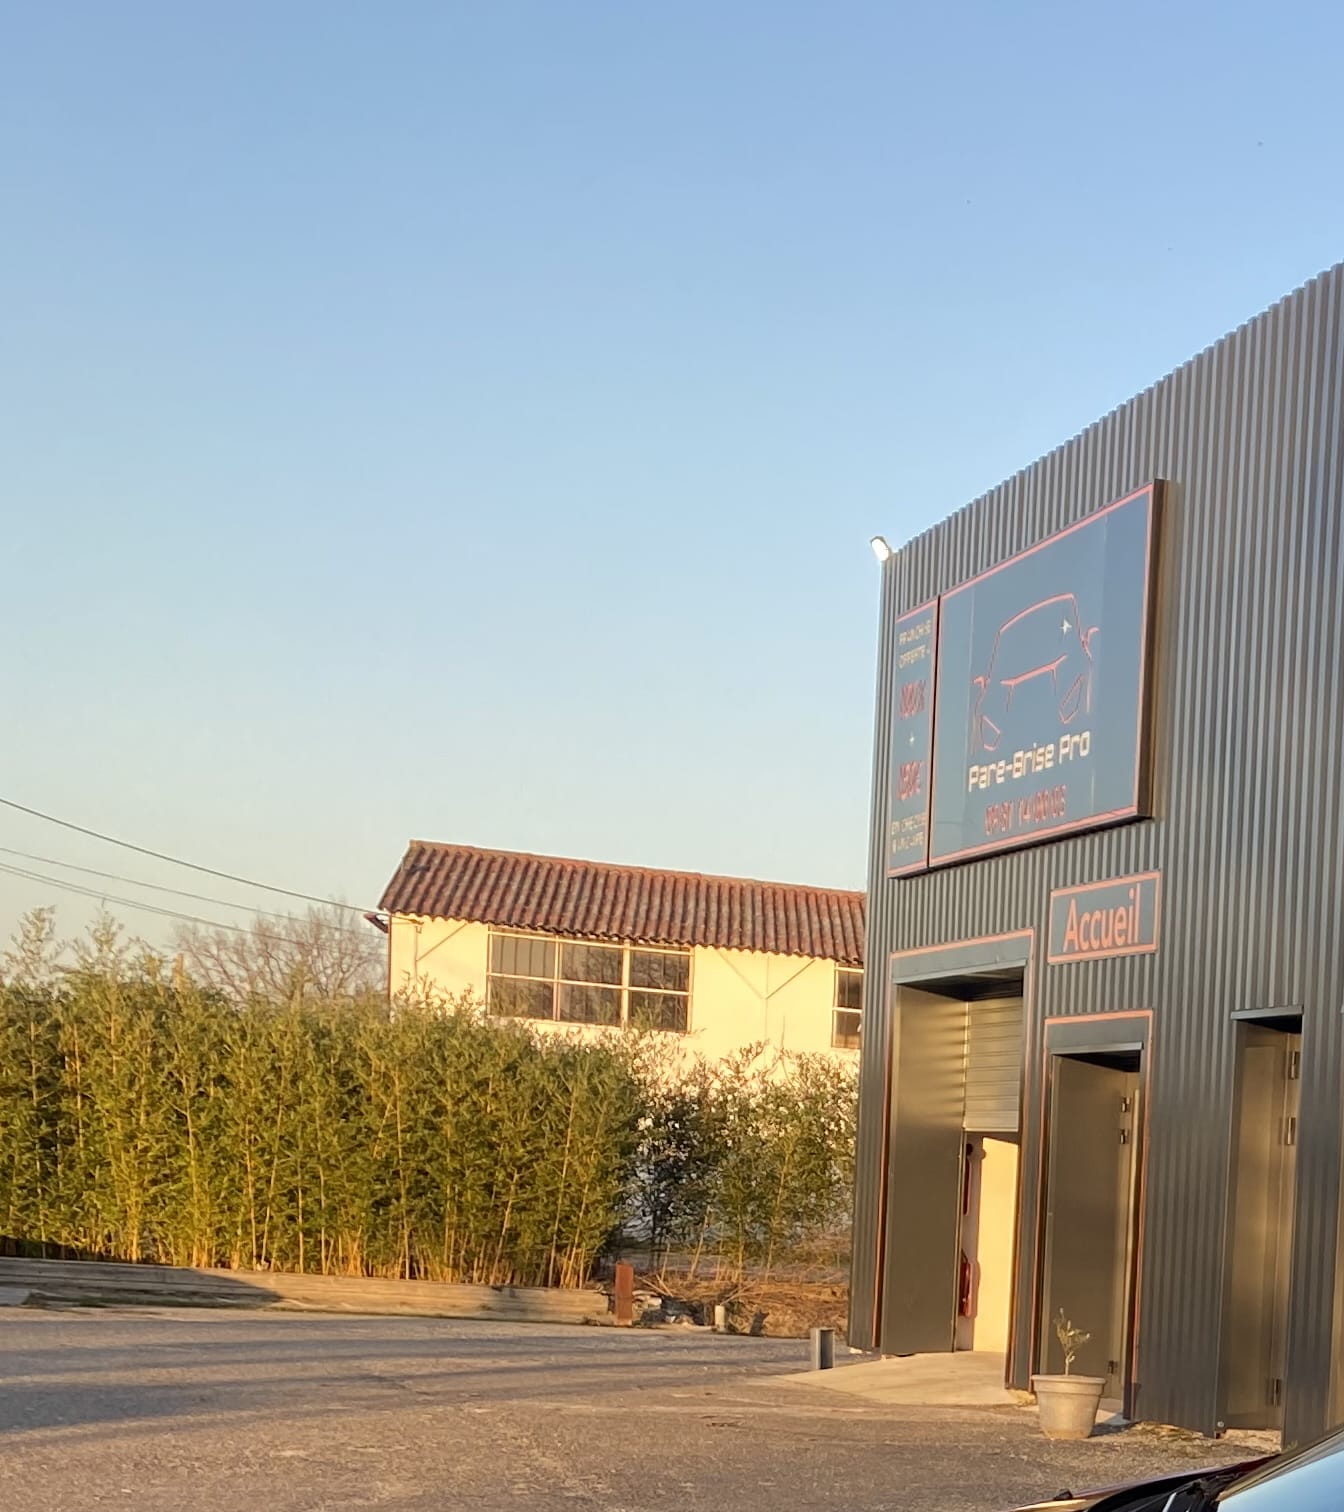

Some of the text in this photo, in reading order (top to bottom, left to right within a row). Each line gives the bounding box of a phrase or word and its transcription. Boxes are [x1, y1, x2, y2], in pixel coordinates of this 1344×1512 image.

[968, 742, 1055, 793] Pare-Brise
[1059, 730, 1091, 765] Pro
[1062, 882, 1141, 953] Accueil
